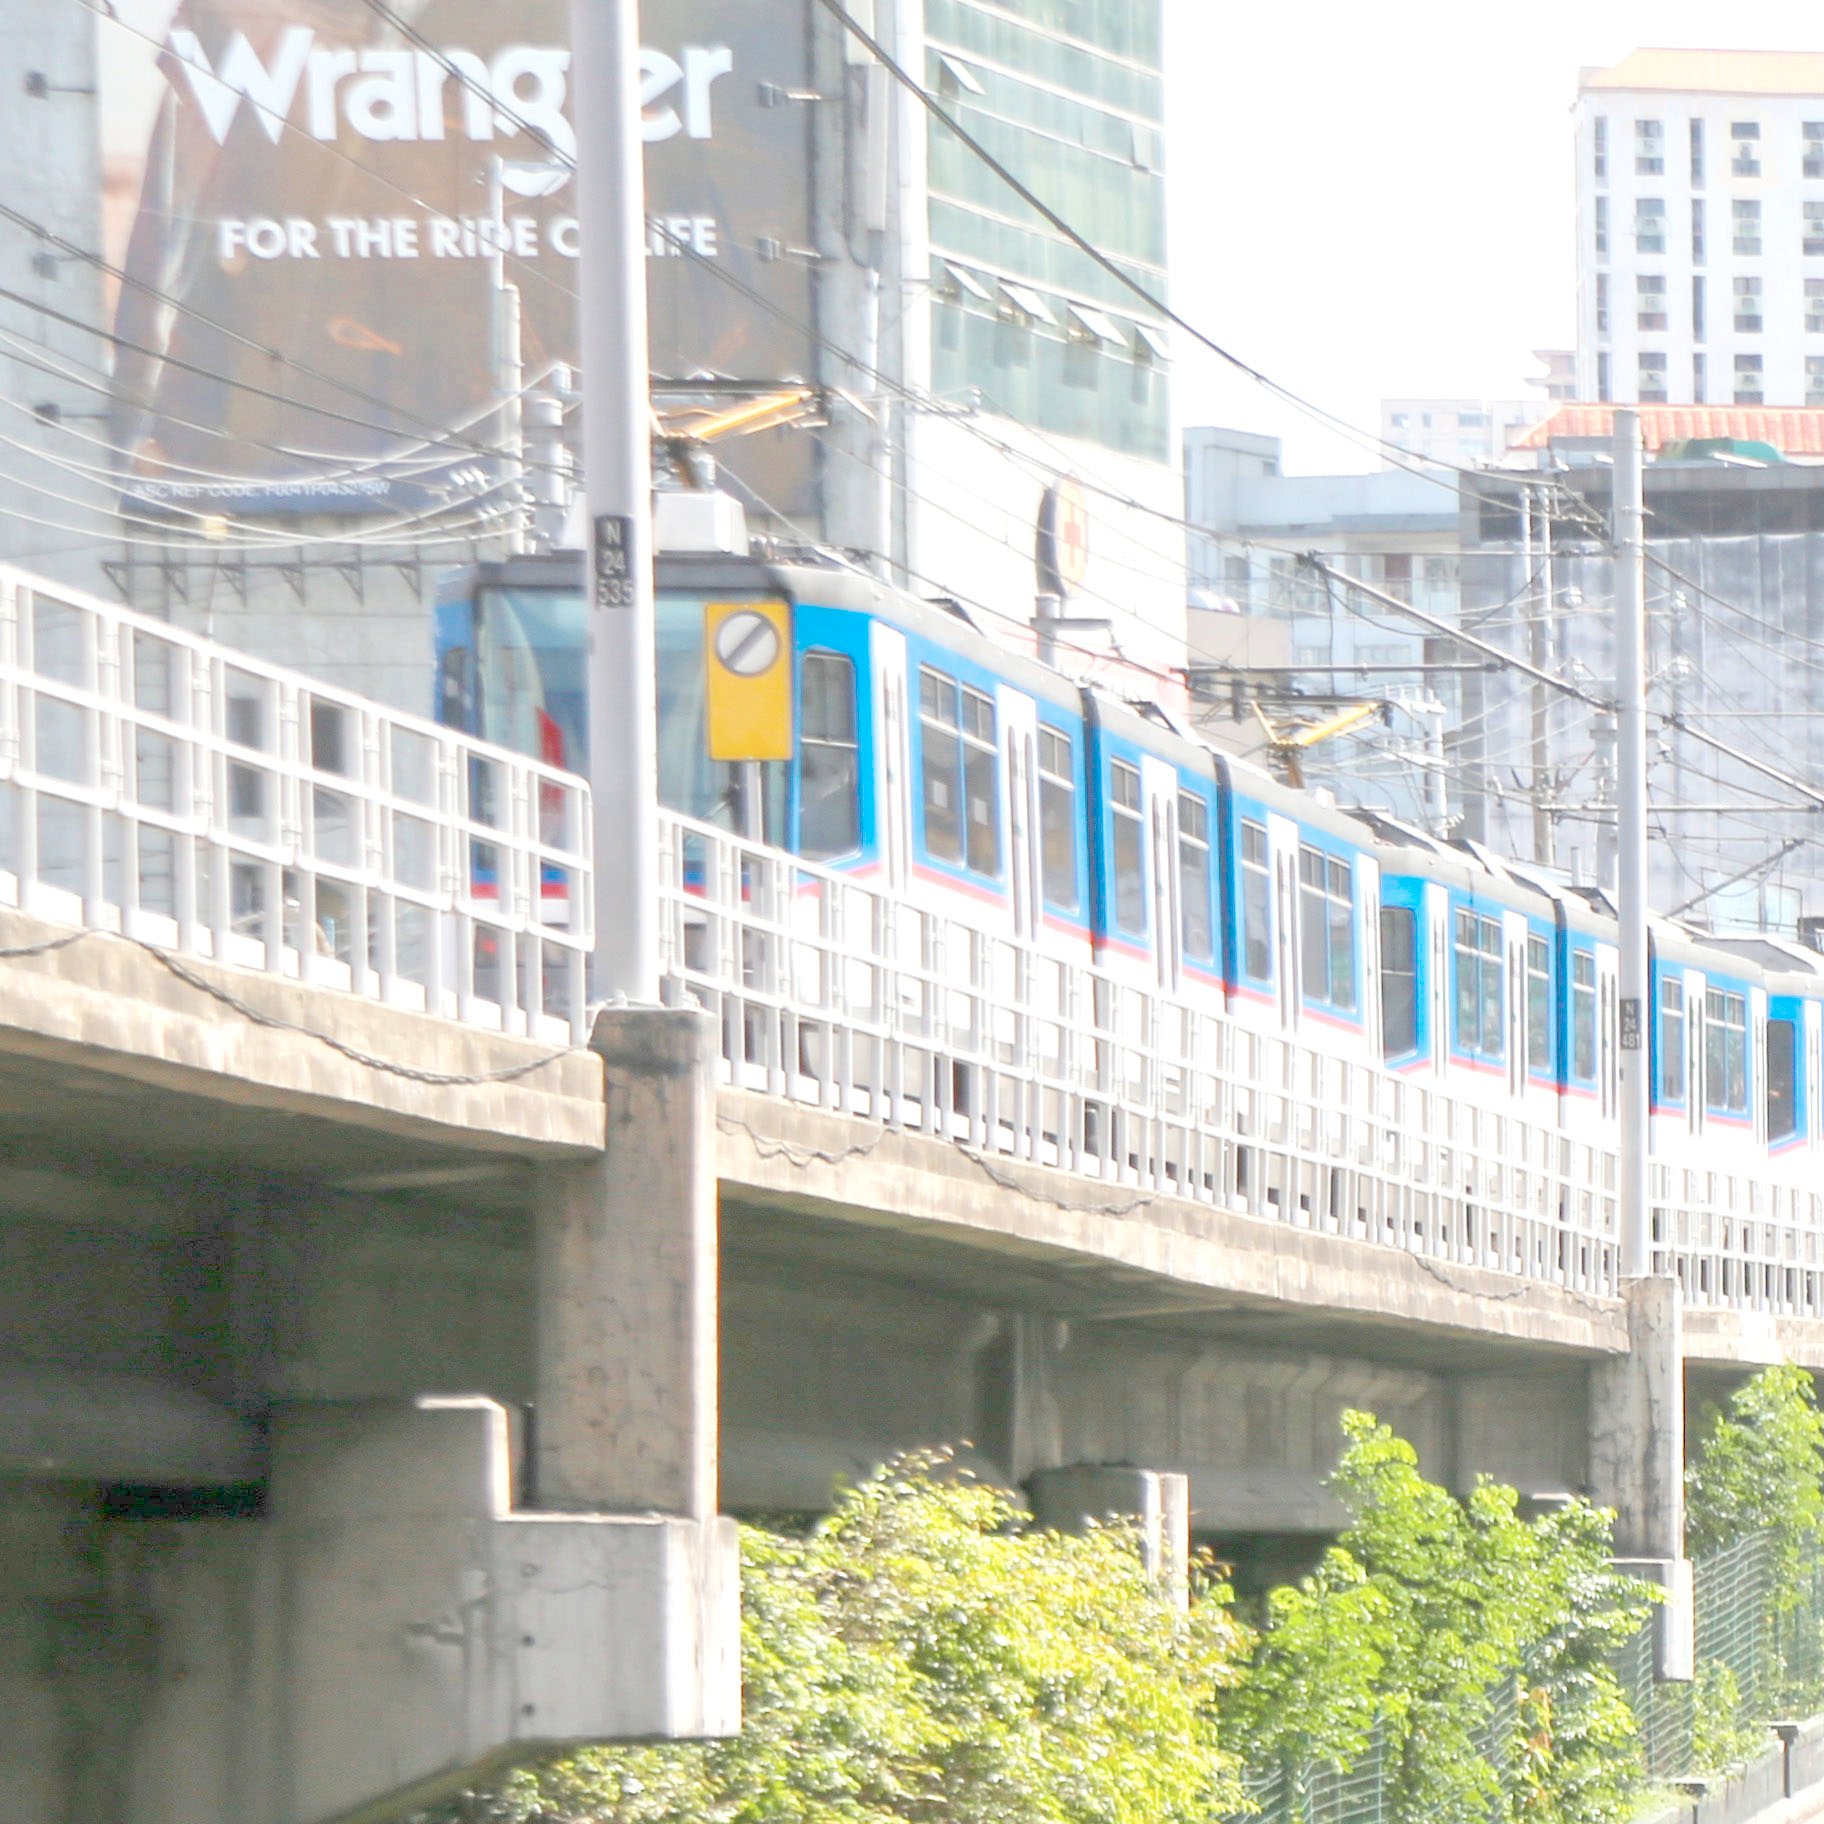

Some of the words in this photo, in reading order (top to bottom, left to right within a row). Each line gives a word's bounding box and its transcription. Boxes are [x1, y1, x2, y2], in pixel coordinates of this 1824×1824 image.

[169, 25, 733, 196] Wranger
[218, 220, 320, 258] FOR
[329, 219, 420, 258] THE
[433, 218, 538, 258] RIDE
[606, 521, 621, 544] N
[604, 550, 625, 575] 24
